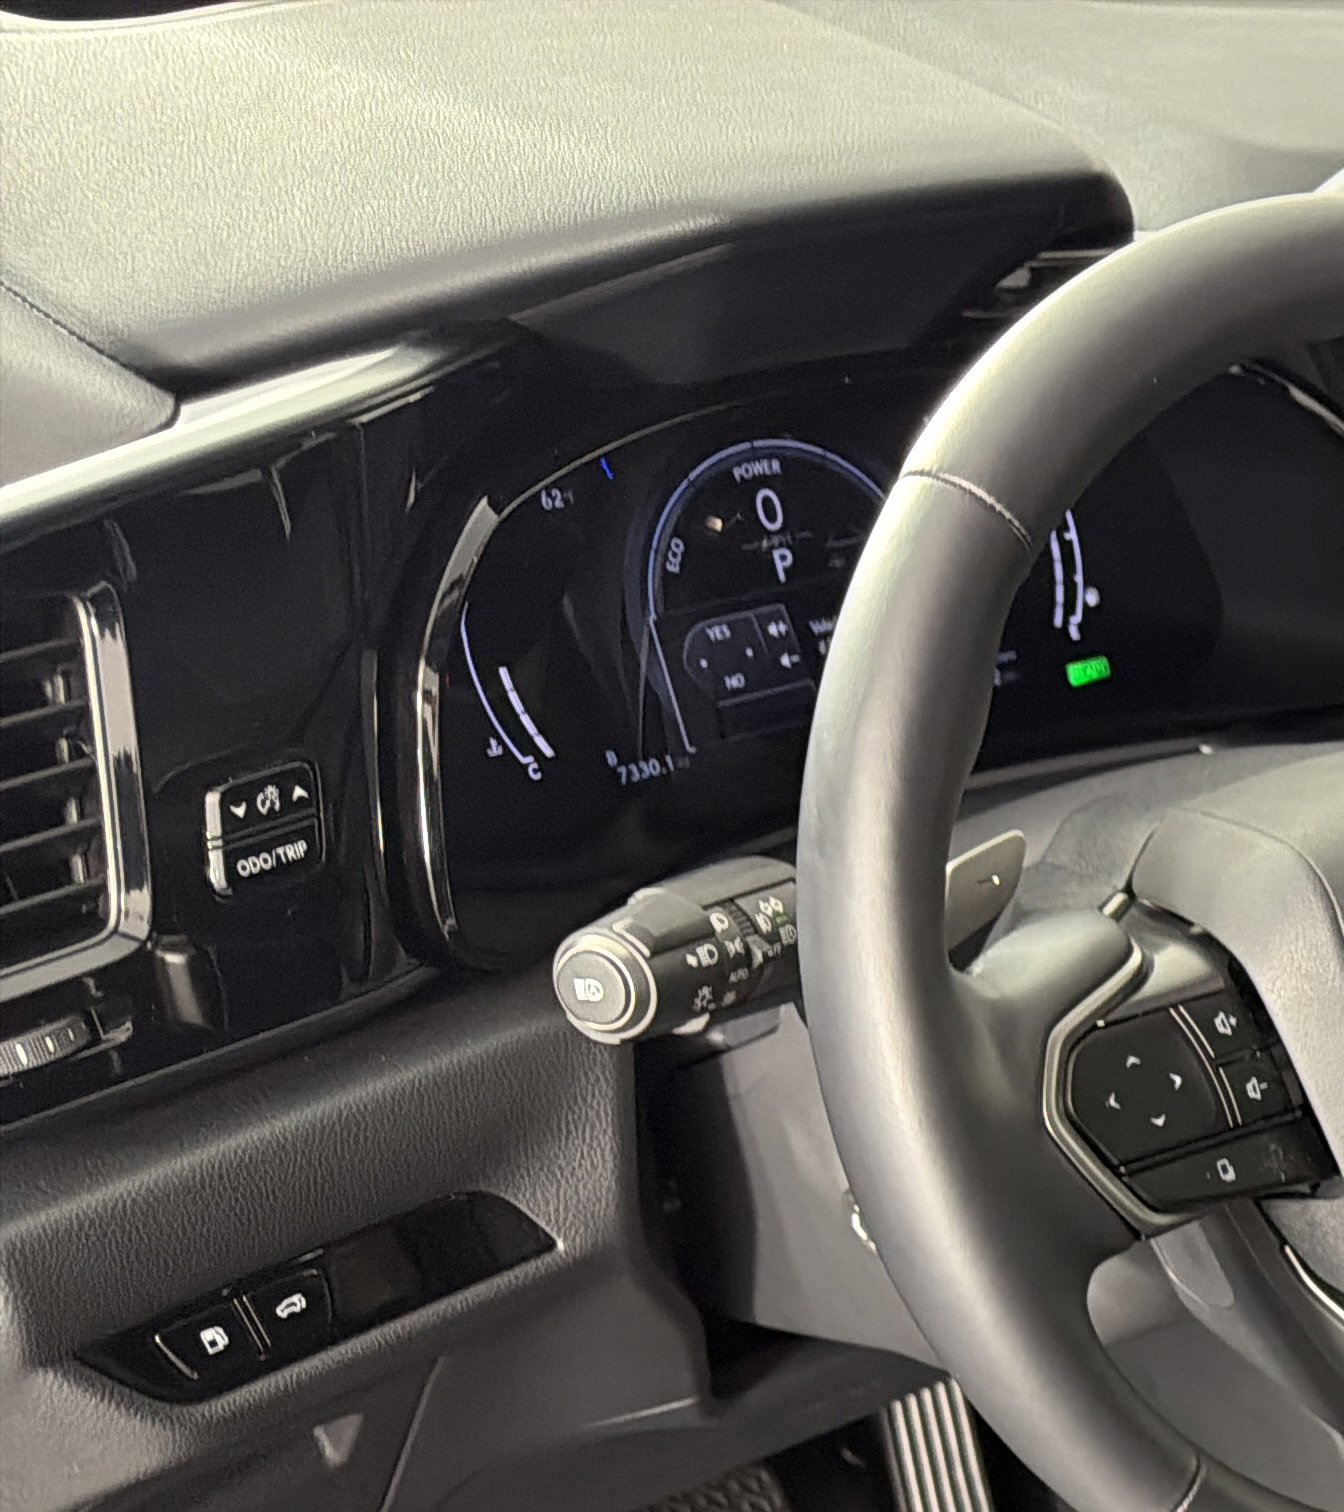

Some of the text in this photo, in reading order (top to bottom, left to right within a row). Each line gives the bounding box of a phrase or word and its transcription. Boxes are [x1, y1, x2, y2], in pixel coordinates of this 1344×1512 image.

[733, 457, 782, 483] POWER
[666, 536, 685, 574] ECO
[772, 547, 793, 584] P
[528, 761, 542, 780] C
[617, 754, 674, 786] 7330.1
[237, 839, 308, 878] ODO/TRIP
